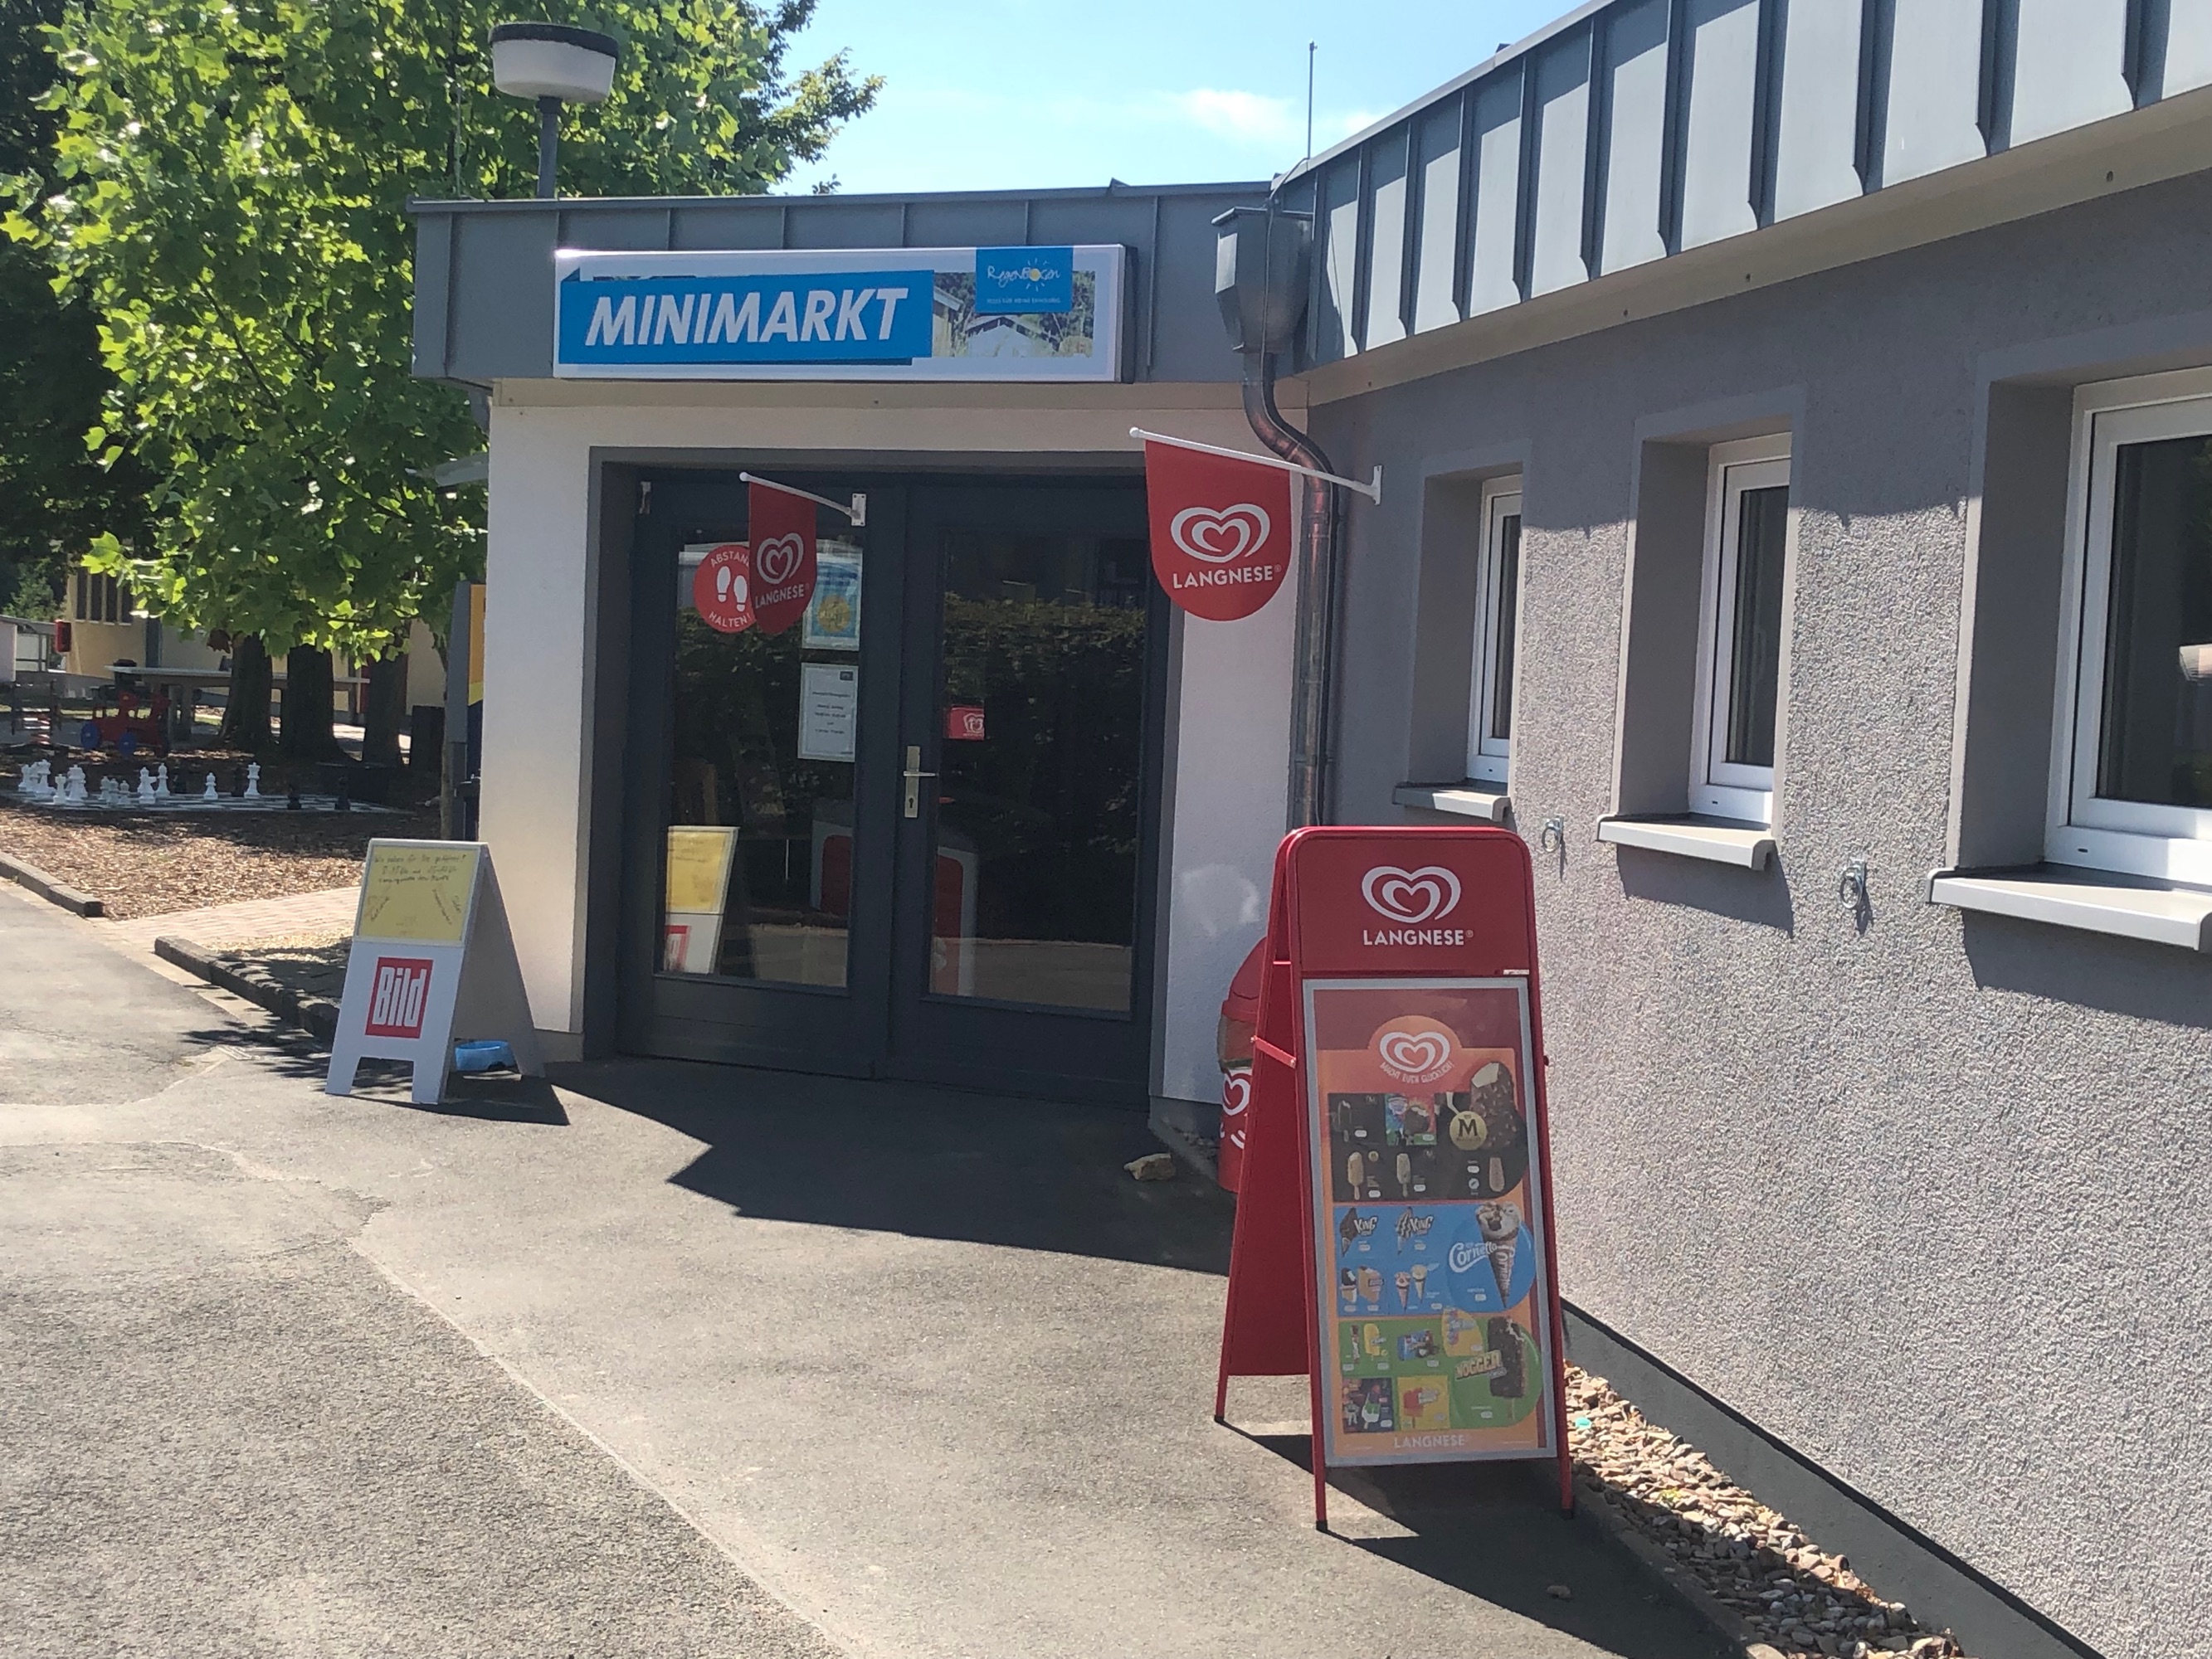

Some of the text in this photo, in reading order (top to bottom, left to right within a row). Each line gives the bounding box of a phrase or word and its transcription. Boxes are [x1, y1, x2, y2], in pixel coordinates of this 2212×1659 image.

[584, 287, 909, 347] MINIMARKT
[711, 551, 749, 567] ABSTAN
[1172, 566, 1274, 589] LANGNESE
[755, 584, 805, 609] LANGNESE
[709, 611, 751, 628] HALTEN!
[1363, 929, 1465, 946] LANGNESE
[371, 966, 427, 1027] Bild
[1449, 1241, 1498, 1273] Cornetto
[1394, 1434, 1465, 1448] LANGNESE
